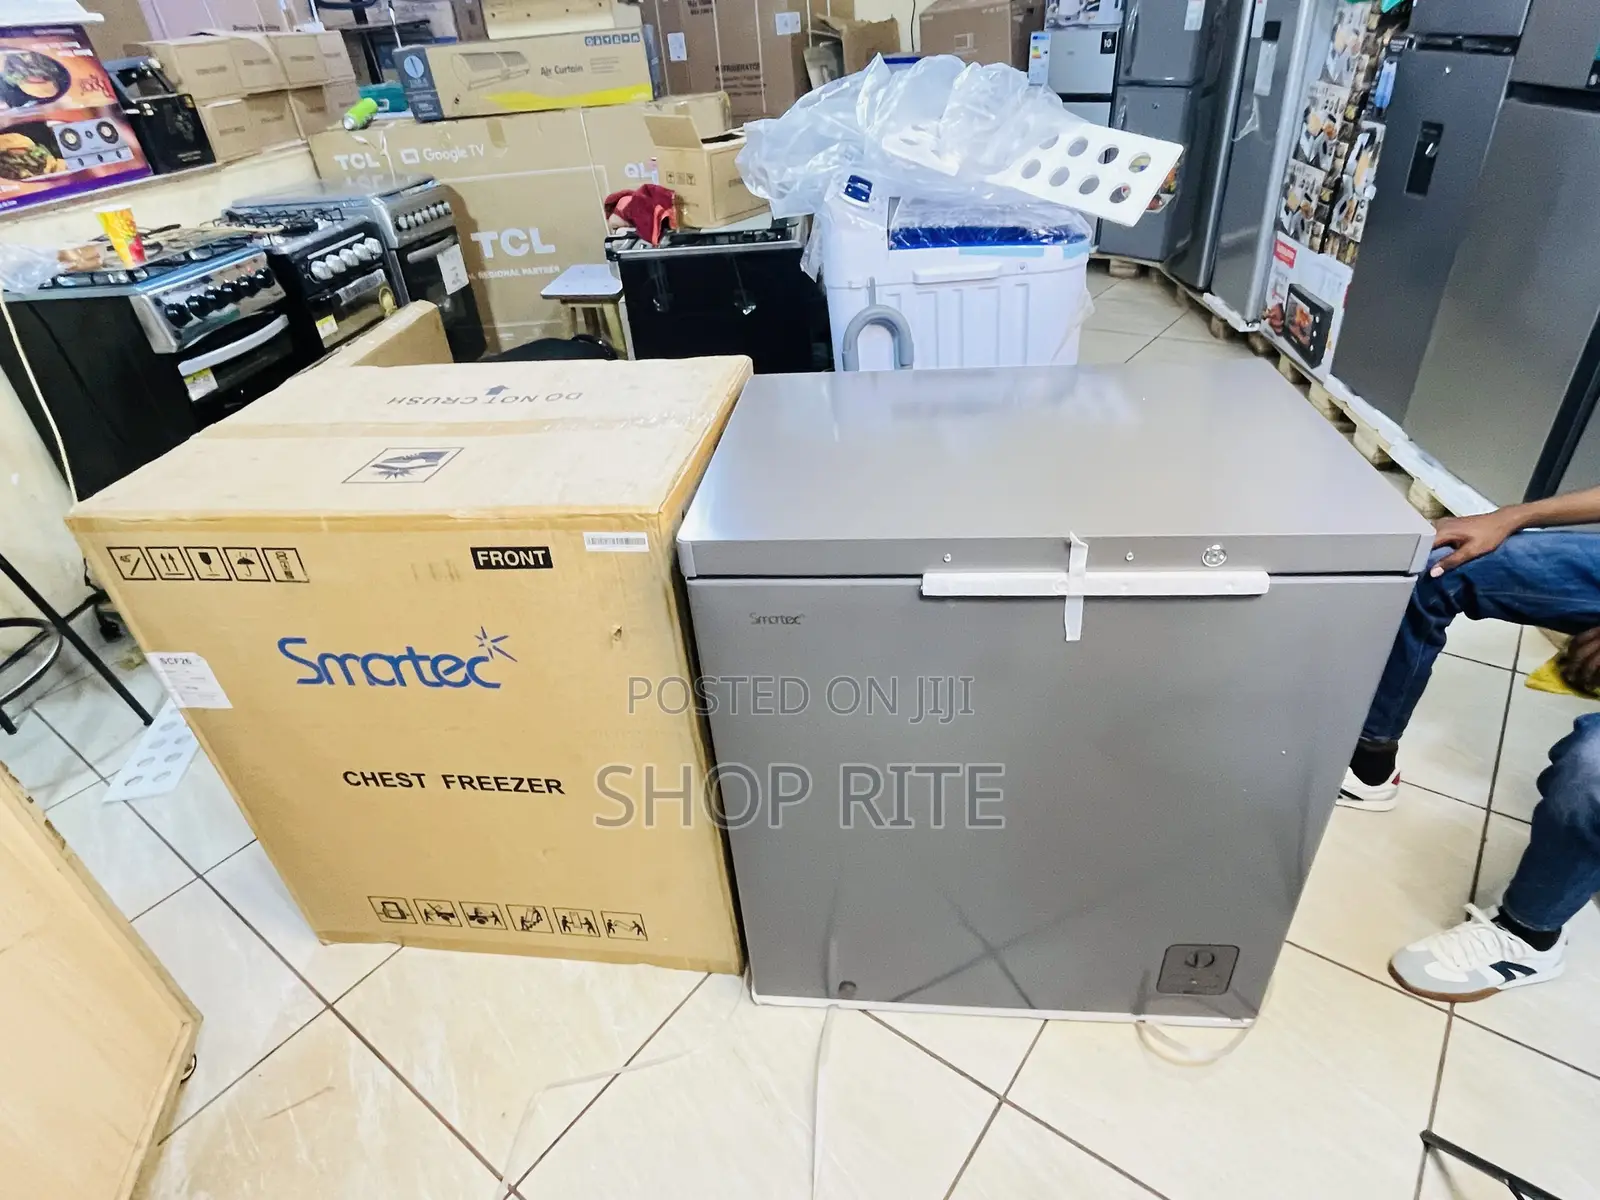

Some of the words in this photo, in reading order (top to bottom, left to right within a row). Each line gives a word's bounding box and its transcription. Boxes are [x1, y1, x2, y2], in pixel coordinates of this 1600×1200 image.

[540, 66, 552, 76] Air
[554, 65, 584, 75] Curtain
[334, 152, 381, 171] TCL
[423, 147, 468, 163] Google
[468, 144, 484, 156] TV
[470, 227, 556, 259] TCL
[478, 267, 521, 280] REGIONAL
[522, 265, 561, 276] PARTNER
[387, 396, 478, 405] CRUSH
[482, 394, 538, 405] NOT
[545, 392, 583, 400] DO
[476, 550, 546, 567] FRONT
[749, 612, 801, 625] Smartec
[277, 636, 502, 689] Smartec
[342, 770, 427, 789] CHEST
[441, 774, 566, 796] FREEZER
